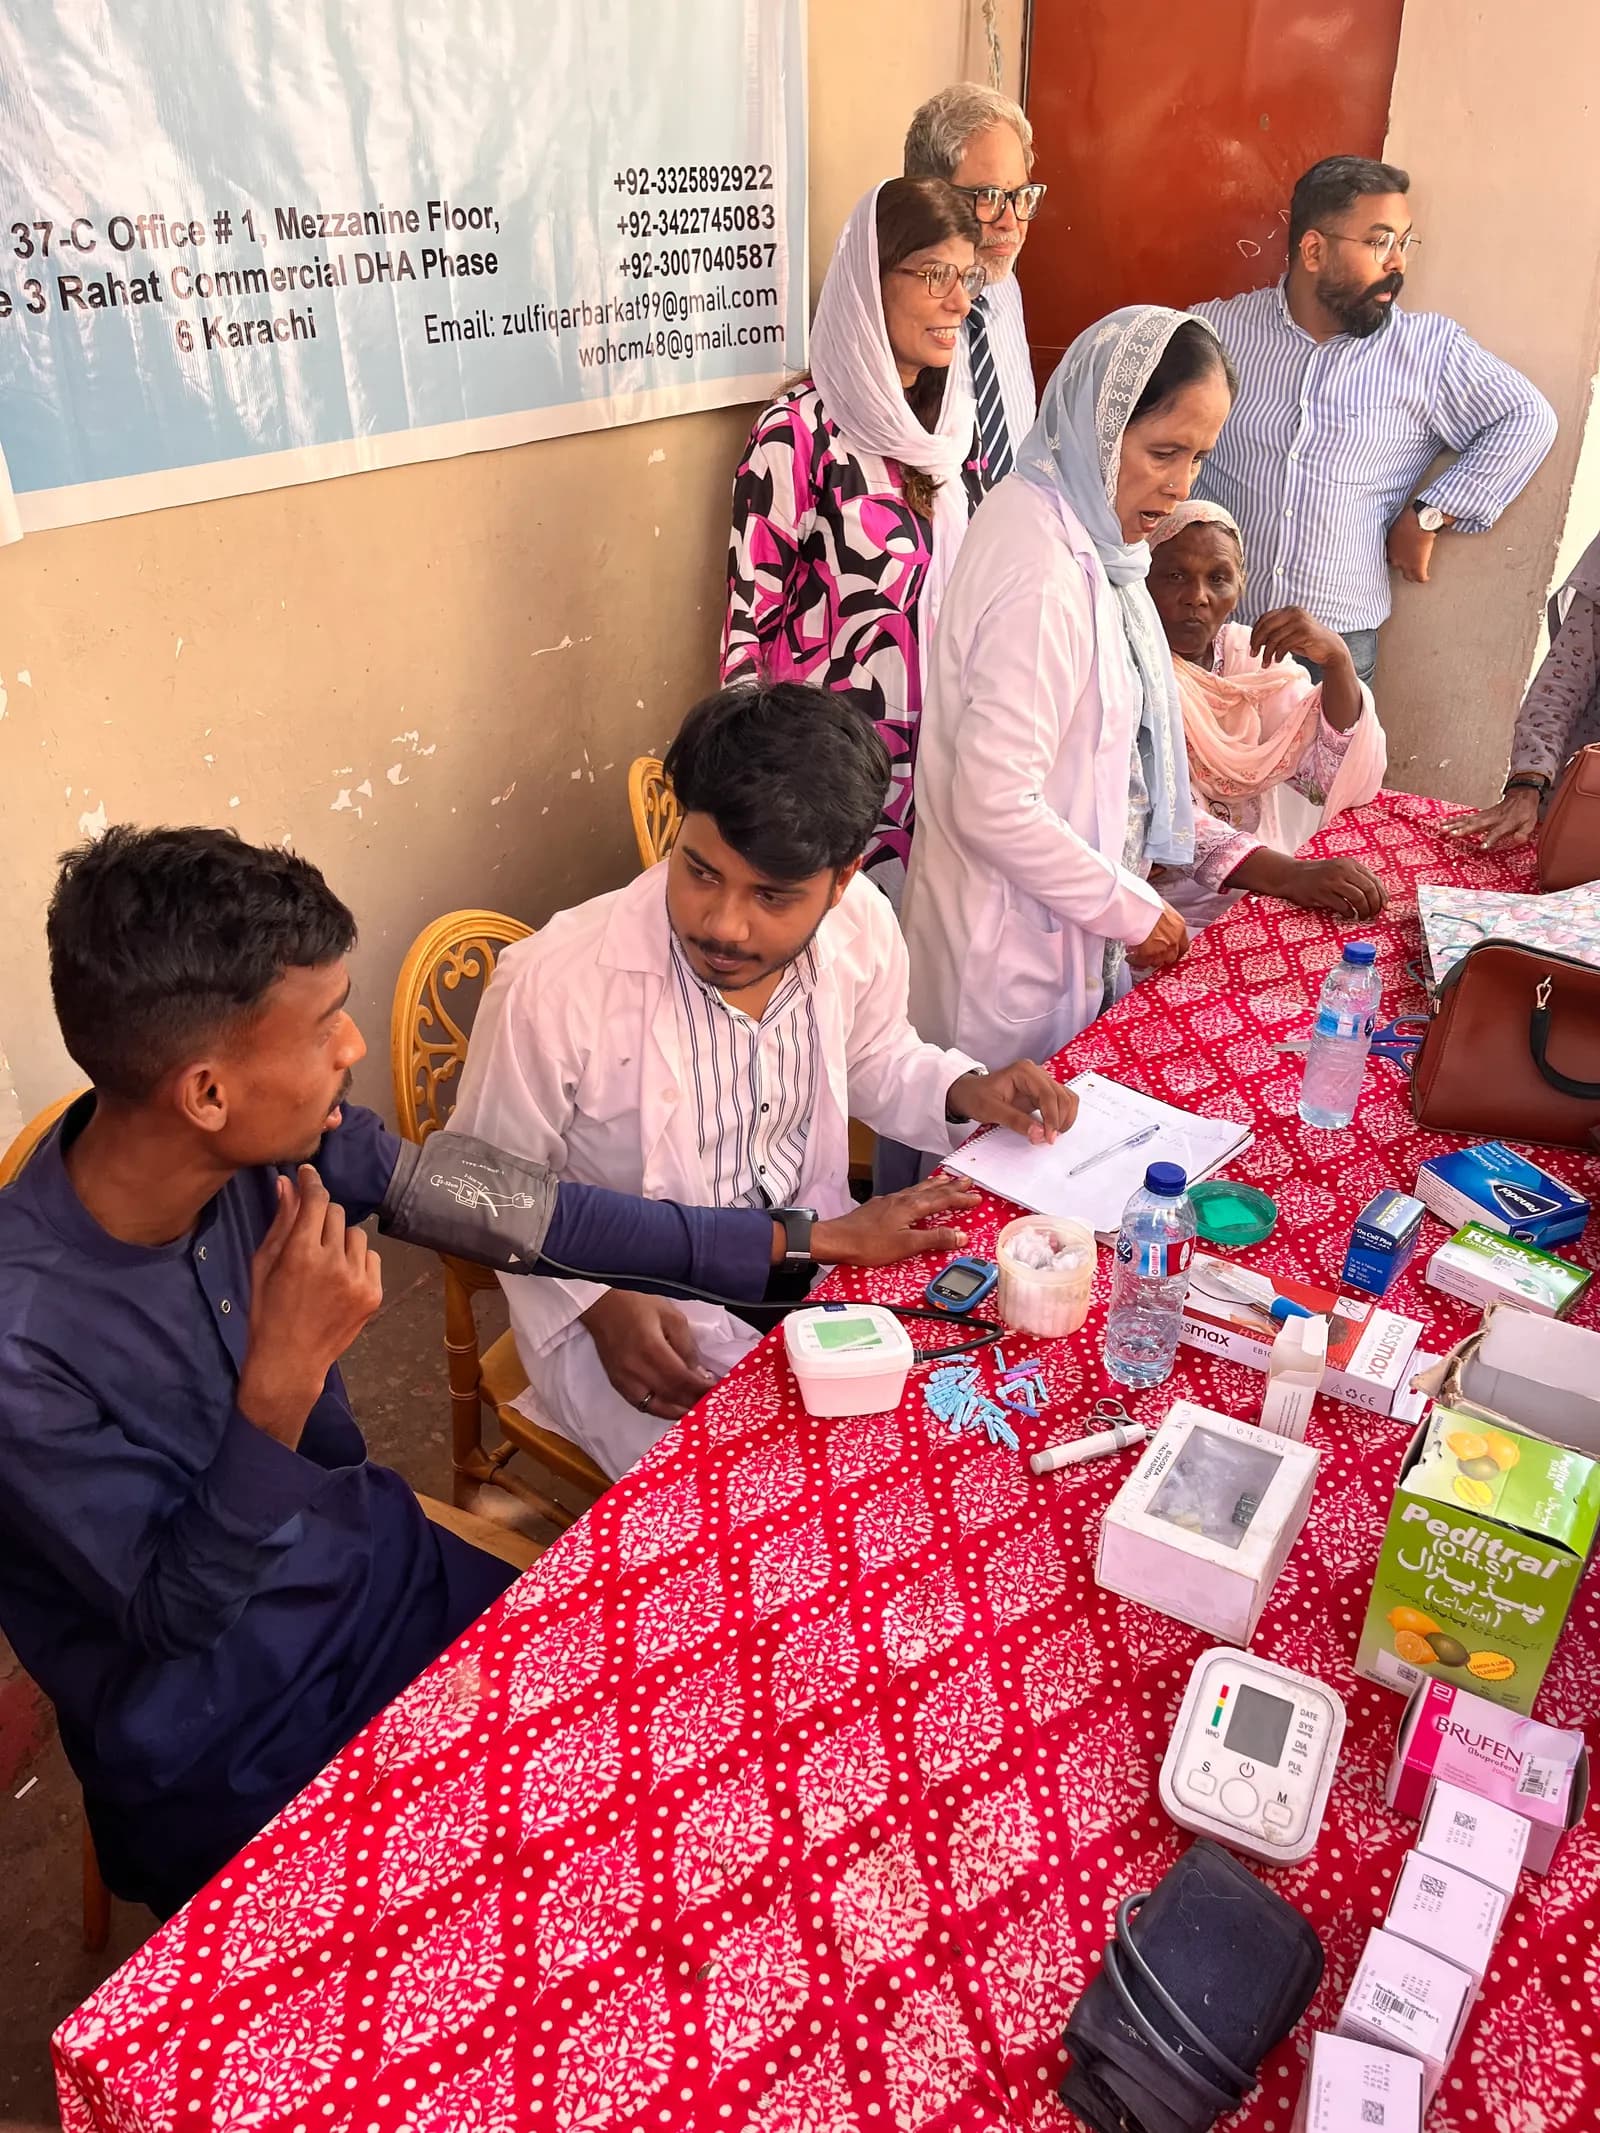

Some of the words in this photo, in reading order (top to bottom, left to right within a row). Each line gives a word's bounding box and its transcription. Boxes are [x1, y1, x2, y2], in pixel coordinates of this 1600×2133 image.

[614, 164, 773, 195] +92-3325892922
[11, 217, 97, 260] 37-C
[108, 213, 206, 252] Office
[213, 210, 233, 244] #
[241, 209, 268, 249] 1,
[274, 203, 420, 240] Mezzanine
[427, 200, 500, 234] Floor,
[617, 204, 776, 238] +92-3422745083
[23, 278, 47, 314] 3
[57, 270, 163, 311] Rahat
[171, 254, 347, 300] Commercial
[354, 250, 417, 284] DHA
[421, 248, 499, 280] Phase
[619, 243, 777, 280] +92-3007040587
[175, 319, 194, 353] 6
[202, 307, 316, 350] Karachi
[424, 309, 495, 344] Email:
[502, 285, 778, 336] zulfiqarbarkat99@gmail.com
[579, 323, 785, 368] wohcm48@gmail.com
[1497, 1187, 1540, 1213] Panadol
[1465, 1230, 1530, 1264] Risek
[1535, 1260, 1568, 1278] 40
[1365, 1317, 1408, 1379] rossmax
[1401, 1503, 1560, 1579] Peditral
[1432, 1538, 1513, 1583] (O.R.S.)
[1298, 1721, 1314, 1733] SYS
[1299, 1708, 1319, 1721] DATE
[1294, 1740, 1307, 1751] DIA
[1435, 1716, 1524, 1767] BRUFEN
[1202, 1761, 1211, 1772] S
[1288, 1761, 1303, 1773] PUL
[1277, 1792, 1287, 1804] M
